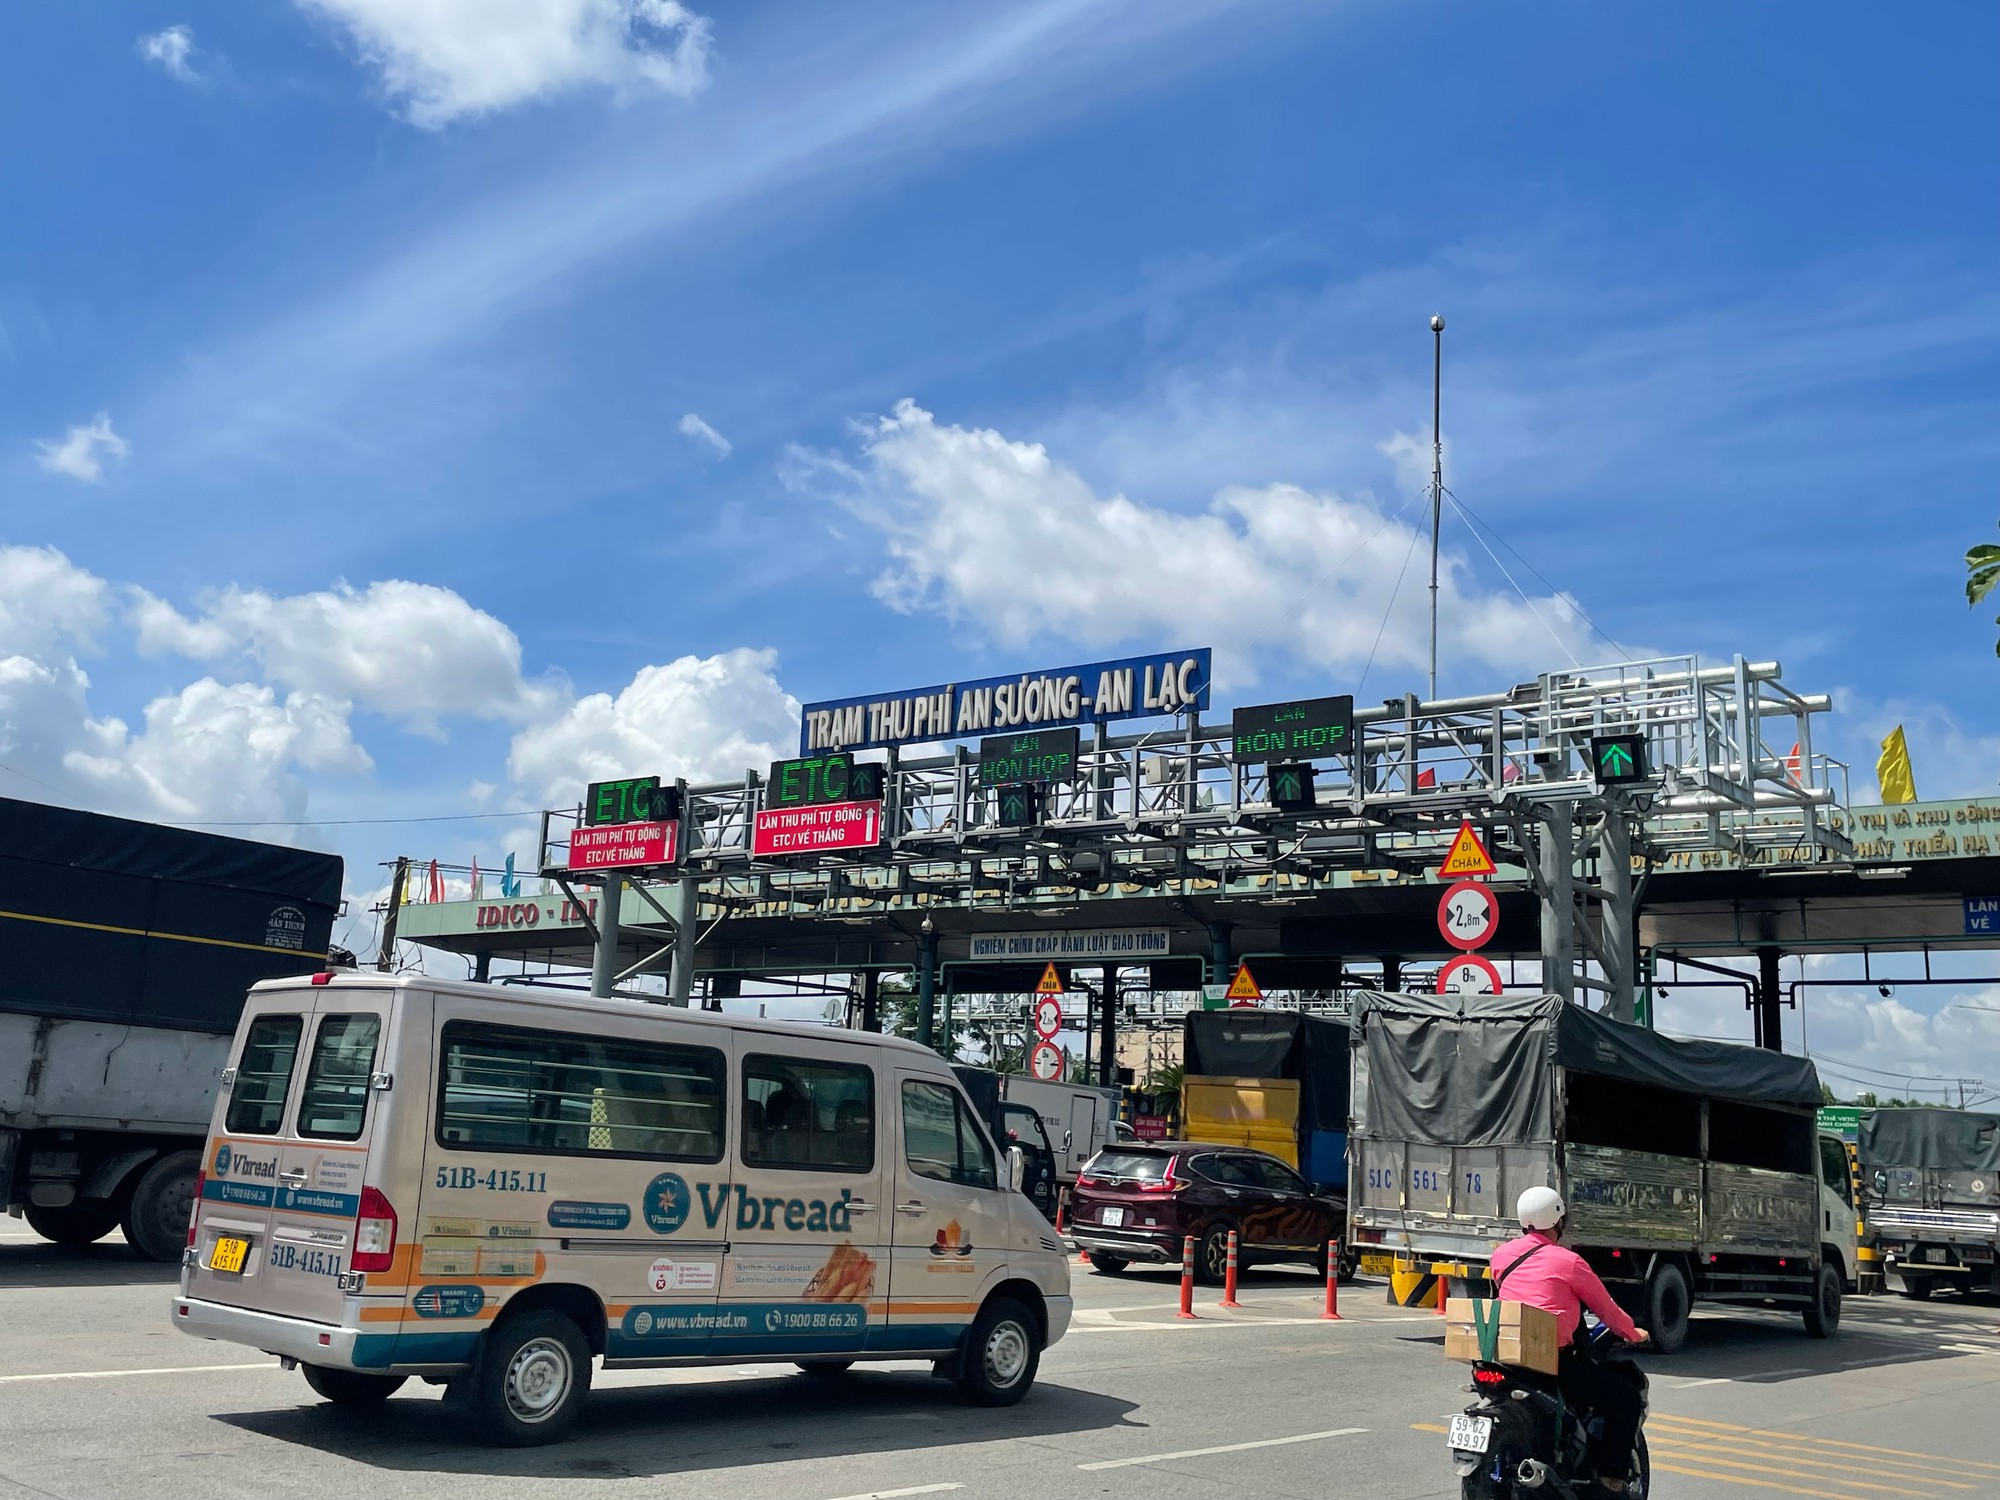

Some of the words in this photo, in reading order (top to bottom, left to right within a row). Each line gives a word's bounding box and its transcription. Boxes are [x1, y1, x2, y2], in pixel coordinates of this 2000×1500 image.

[807, 705, 865, 752] TRẠM
[869, 699, 911, 742] THU
[914, 684, 954, 737] PHÍ
[958, 688, 992, 731] AN
[995, 675, 1080, 727] SƯƠNG
[1094, 668, 1133, 714] AN
[1144, 659, 1198, 712] LẠC
[781, 758, 847, 801] ETC
[596, 779, 650, 821] ETC
[760, 814, 778, 829] LÀN
[780, 814, 798, 827] THU
[801, 810, 817, 825] PHÍ
[819, 810, 832, 825] TỰ
[835, 806, 862, 823] ĐỘNG
[1860, 813, 1886, 832] THỊ
[1892, 808, 1911, 826] VÀ
[1916, 809, 1949, 825] KHU
[1955, 804, 2000, 822] CÔNG
[574, 831, 592, 847] LÀN
[592, 833, 608, 846] THU
[610, 829, 624, 845] PHÍ
[625, 829, 637, 844] TỰ
[640, 826, 661, 842] ĐỘNG
[813, 828, 845, 843] THÁNG
[1461, 842, 1471, 852] ĐI
[618, 846, 645, 861] THÁNG
[1672, 851, 1691, 867] TY
[1903, 829, 1956, 855] TRIỂN
[476, 893, 539, 927] IDICO
[1456, 904, 1480, 928] 2,8m
[1969, 899, 1998, 913] LÀN
[1970, 915, 1990, 929] VÉ
[974, 936, 1006, 955] NGHIÊM
[1112, 933, 1133, 951] GIAO
[1136, 930, 1166, 951] THÔNG
[1462, 967, 1476, 983] 8m
[233, 1153, 277, 1179] Vbread
[436, 1166, 547, 1193] 51B-415.11
[1369, 1168, 1392, 1189] 51C
[1413, 1169, 1438, 1192] 561
[1466, 1173, 1482, 1194] 78
[695, 1182, 852, 1233] Vbread
[223, 1239, 239, 1254] 51B
[214, 1254, 239, 1270] 415.11
[270, 1244, 342, 1277] 51B-415.11
[656, 1312, 747, 1329] www.vbread.vn
[784, 1313, 809, 1328] 1900
[814, 1313, 826, 1328] 88
[829, 1313, 842, 1328] 66
[844, 1313, 858, 1328] 26
[1450, 1432, 1486, 1450] 499.97
